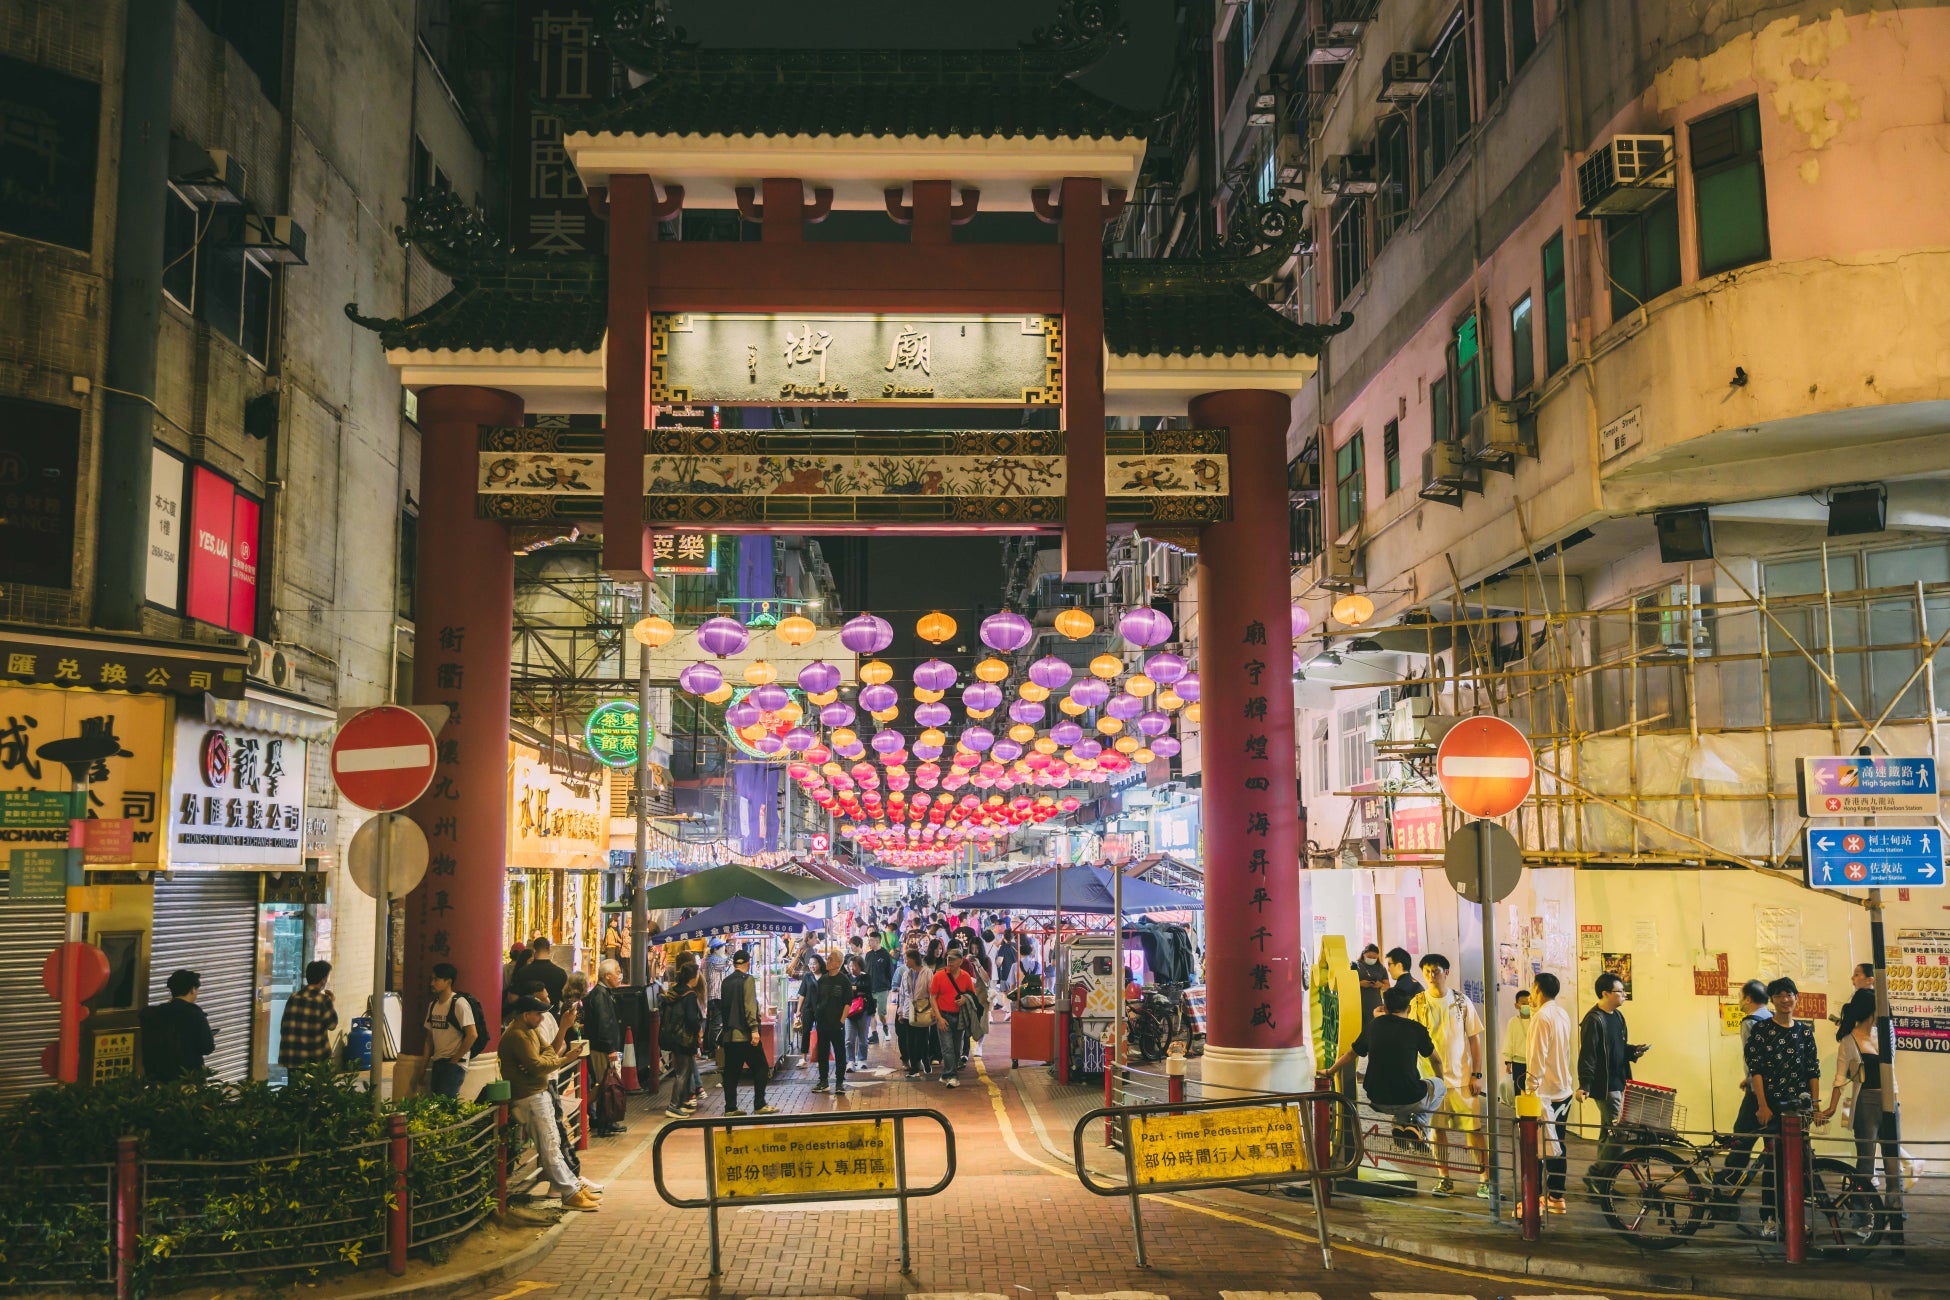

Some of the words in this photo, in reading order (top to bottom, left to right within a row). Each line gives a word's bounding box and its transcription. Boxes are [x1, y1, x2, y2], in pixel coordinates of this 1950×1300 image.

[780, 382, 848, 396] Temple
[882, 382, 934, 395] Street
[1603, 426, 1618, 439] Temple
[1622, 414, 1636, 428] Street
[155, 494, 176, 518] 本大廈
[199, 529, 228, 560] YES,UA
[653, 534, 705, 560] 耍樂
[1862, 766, 1913, 778] 高速鐵路
[1862, 780, 1878, 788] High
[1879, 780, 1900, 788] Speed
[1844, 797, 1895, 805] 香港西九龍站
[183, 833, 215, 845] HONESTY
[219, 834, 241, 846] MONEY
[243, 836, 273, 848] EXCHANGE
[274, 838, 299, 848] COMPANY
[1868, 834, 1912, 846] 柯士甸站
[1870, 862, 1902, 874] 佐敦站
[1916, 955, 1926, 965] 租
[1938, 955, 1948, 965] 售
[1916, 966, 1947, 979] 9966
[1141, 1133, 1164, 1143] Part
[1177, 1130, 1199, 1140] time
[1203, 1125, 1263, 1137] Pedestrian
[1266, 1121, 1293, 1132] Area
[725, 1145, 749, 1155] Part
[762, 1143, 786, 1153] time
[790, 1139, 852, 1152] Pedestrian
[857, 1139, 884, 1149] Area
[1145, 1141, 1297, 1168] 部份時間行人專用區
